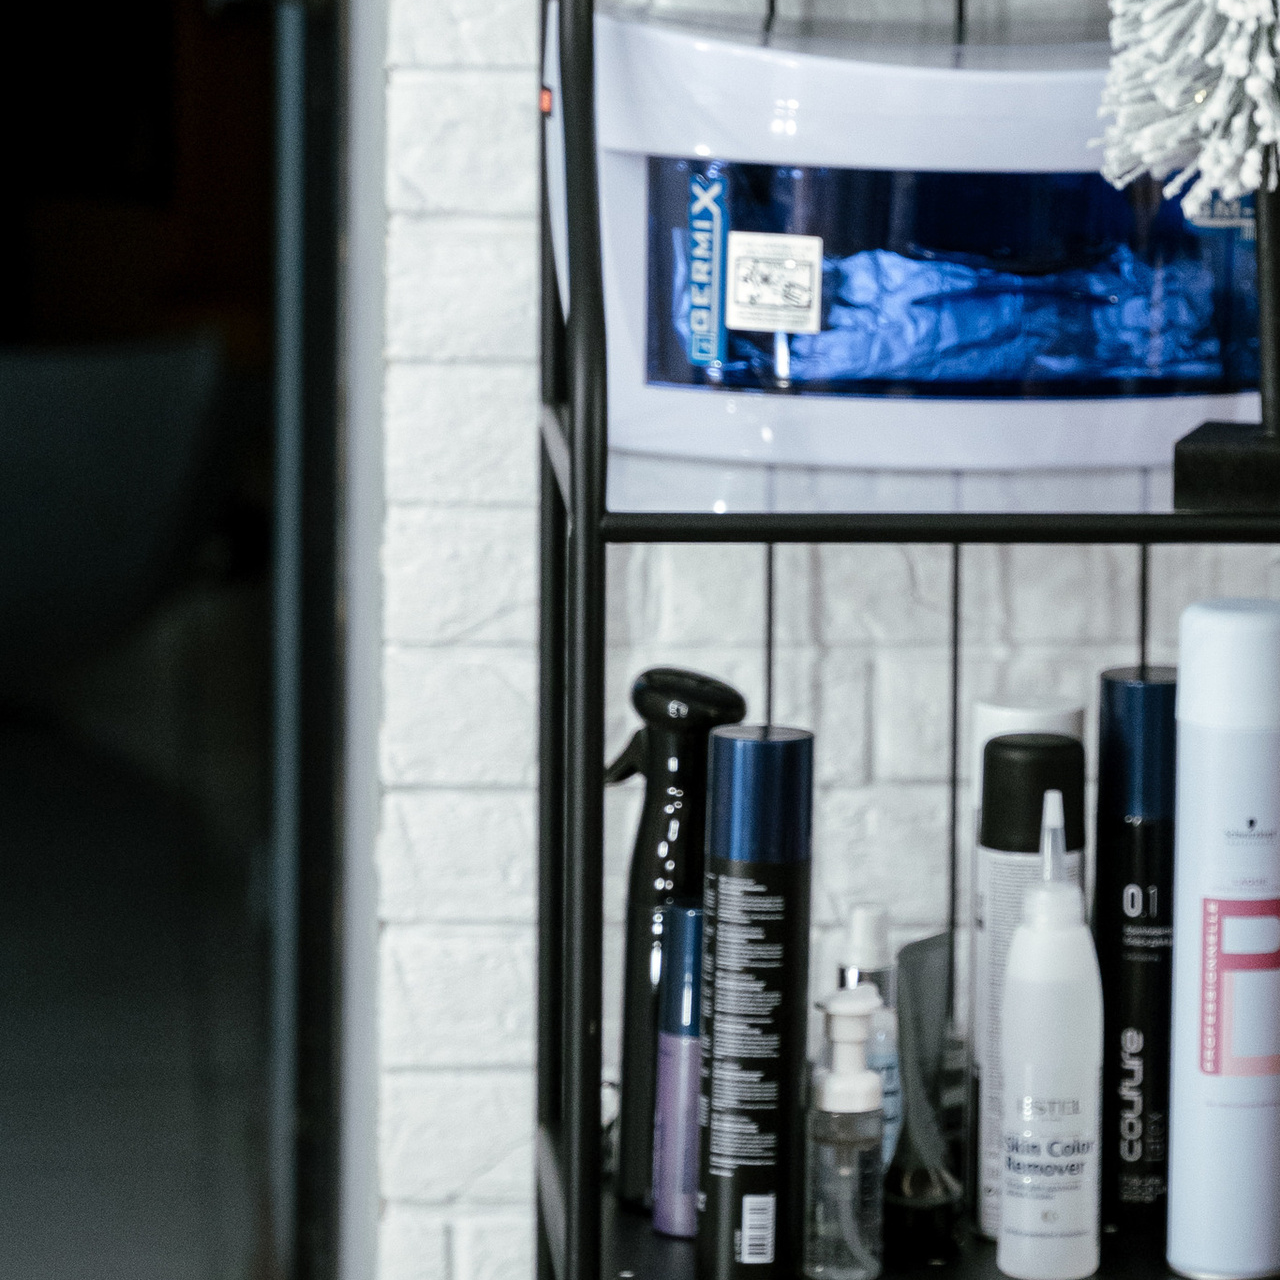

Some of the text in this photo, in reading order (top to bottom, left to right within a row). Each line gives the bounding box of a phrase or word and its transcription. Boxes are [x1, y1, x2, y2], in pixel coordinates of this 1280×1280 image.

[1119, 1026, 1145, 1162] couture
[1047, 1138, 1095, 1158] Color
[1005, 1156, 1086, 1177] Remover
